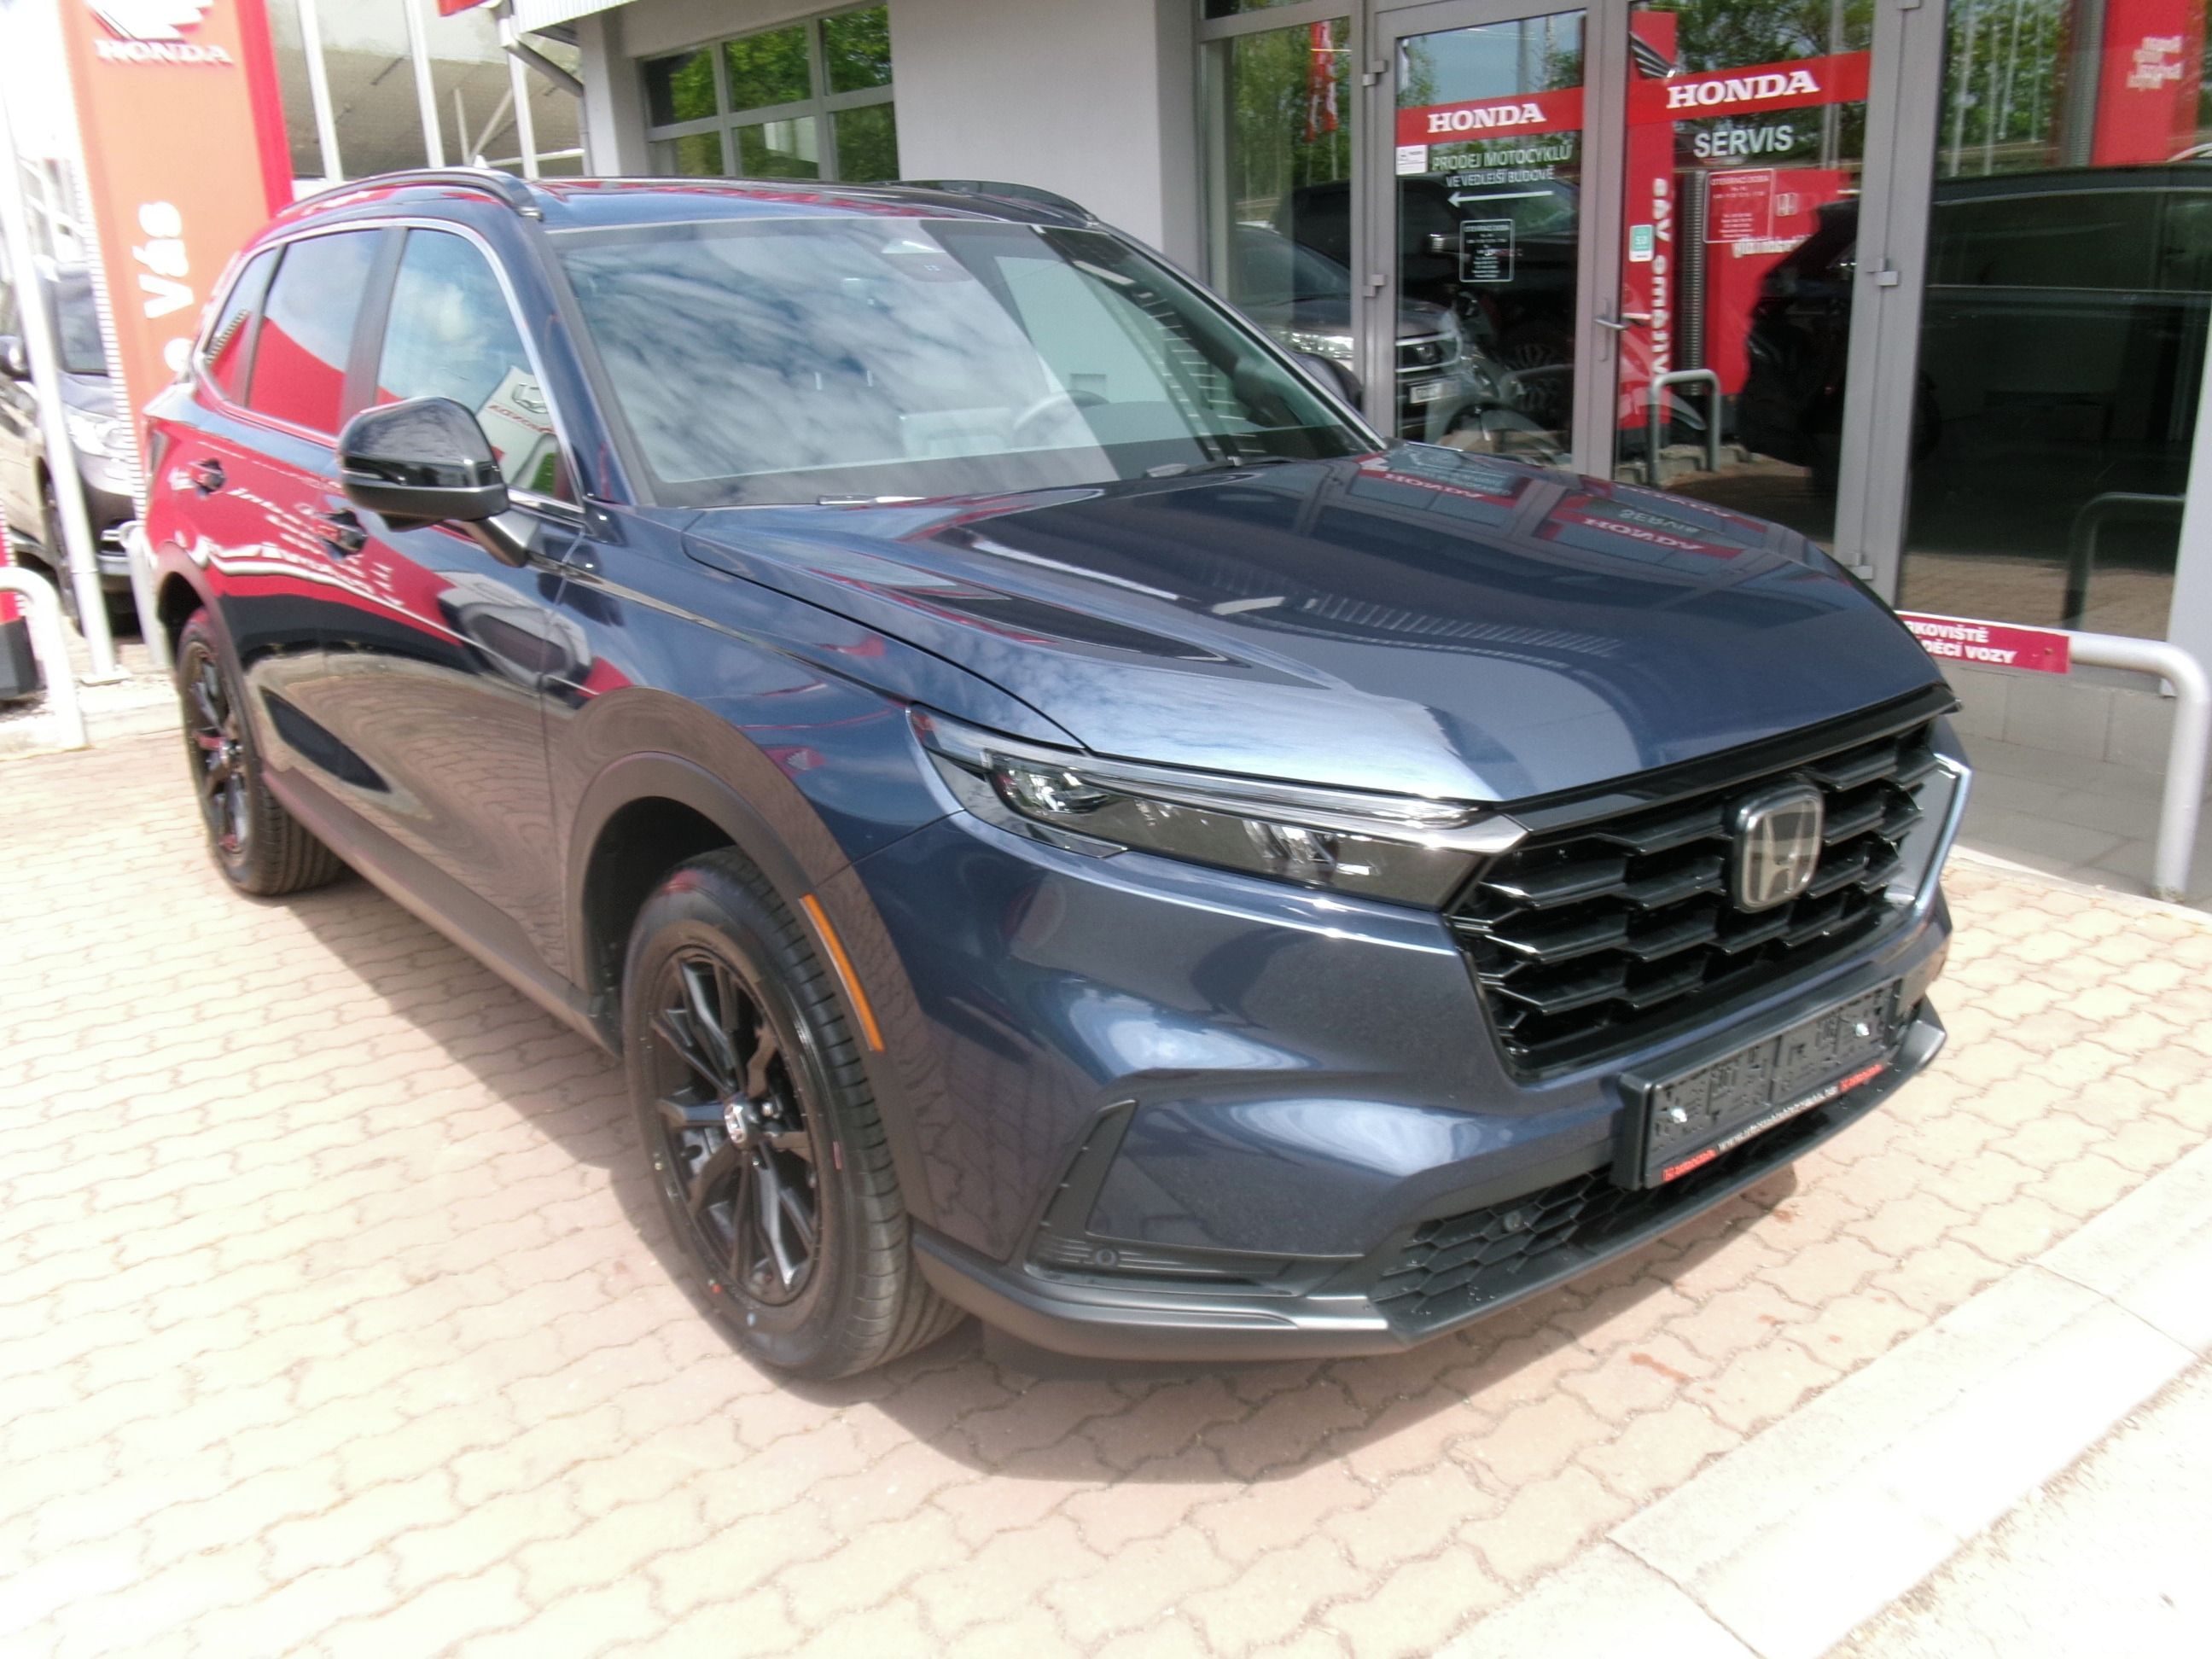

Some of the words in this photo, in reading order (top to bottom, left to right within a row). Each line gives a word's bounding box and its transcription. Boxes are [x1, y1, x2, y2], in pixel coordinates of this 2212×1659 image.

[92, 39, 234, 66] HONDA
[1666, 70, 1821, 109] HONDA
[1427, 102, 1547, 134] HONDA
[1693, 125, 1795, 159] SERVIS
[1431, 152, 1482, 172] PRODEJ
[1964, 644, 2018, 665] VOZY
